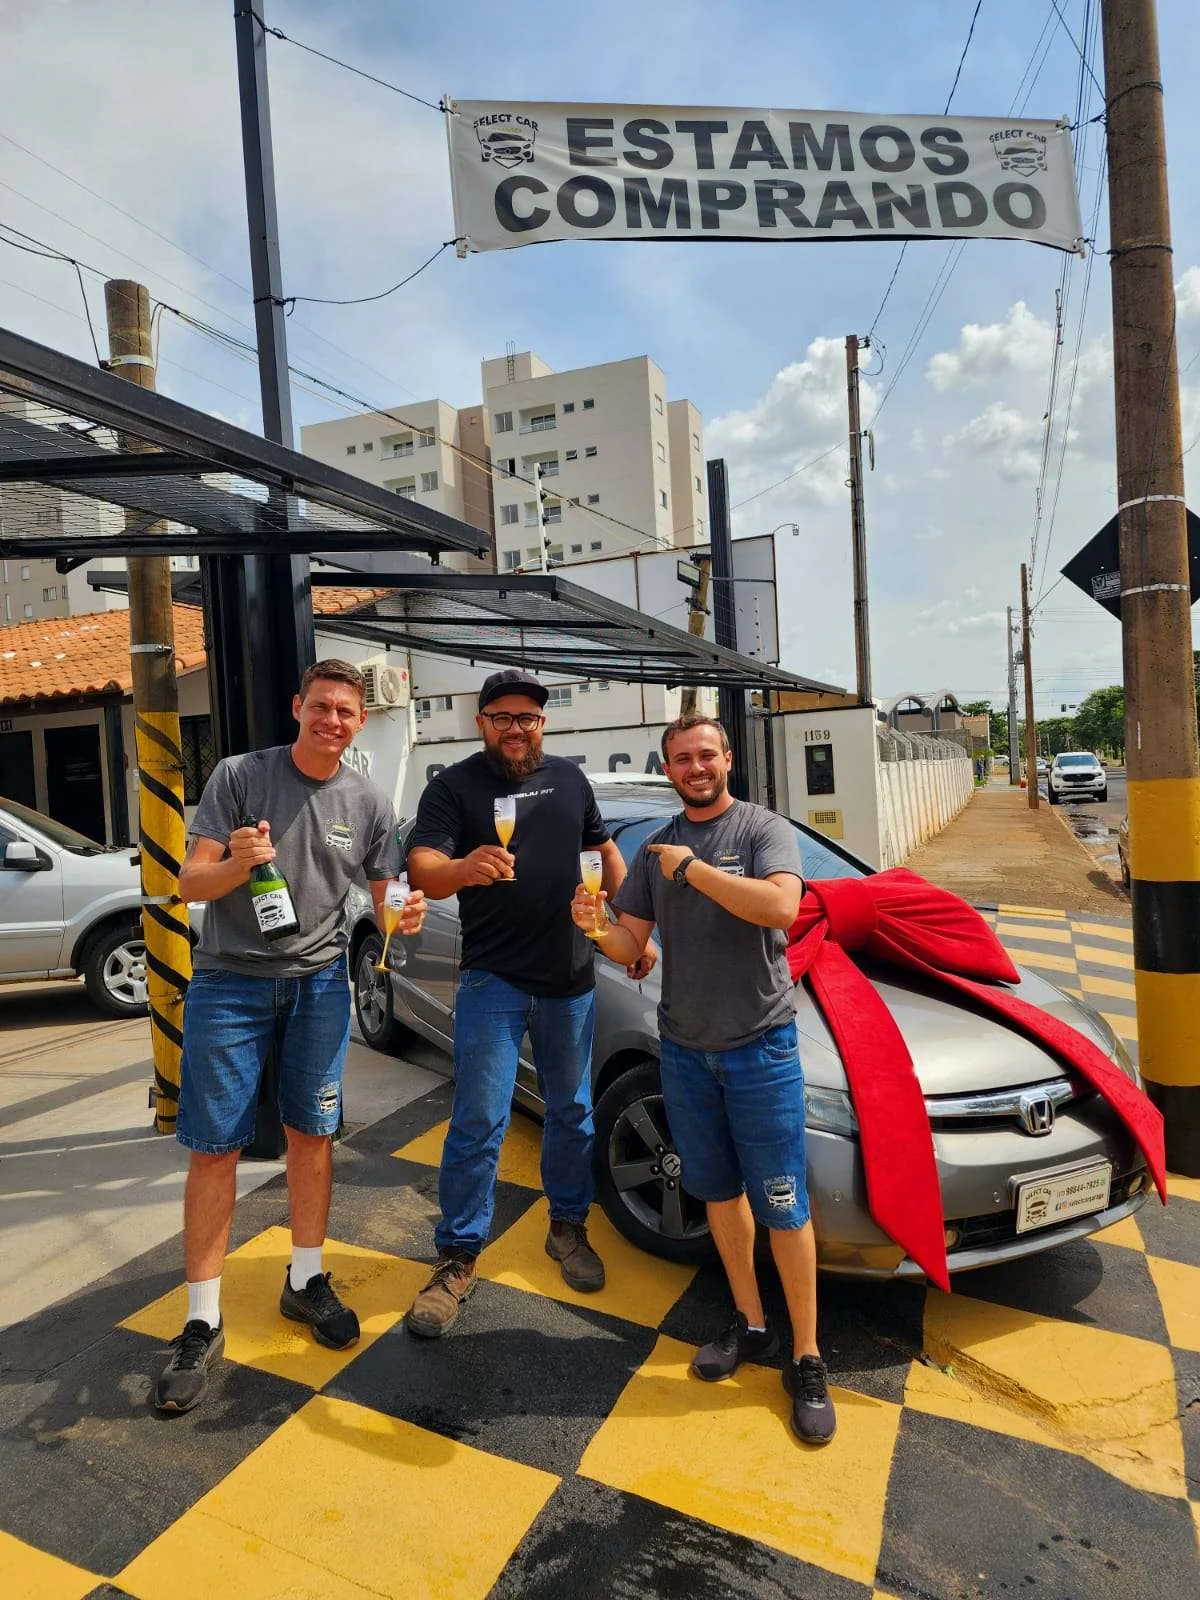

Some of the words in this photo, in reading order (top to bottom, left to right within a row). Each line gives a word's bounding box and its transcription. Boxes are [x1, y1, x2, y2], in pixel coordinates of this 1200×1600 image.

[473, 114, 512, 128] SELECT
[516, 116, 538, 131] CAR
[989, 129, 1023, 143] SELECT
[566, 118, 970, 176] ESTAMOS
[494, 174, 1047, 233] COMPRANDO
[804, 729, 831, 742] 1159
